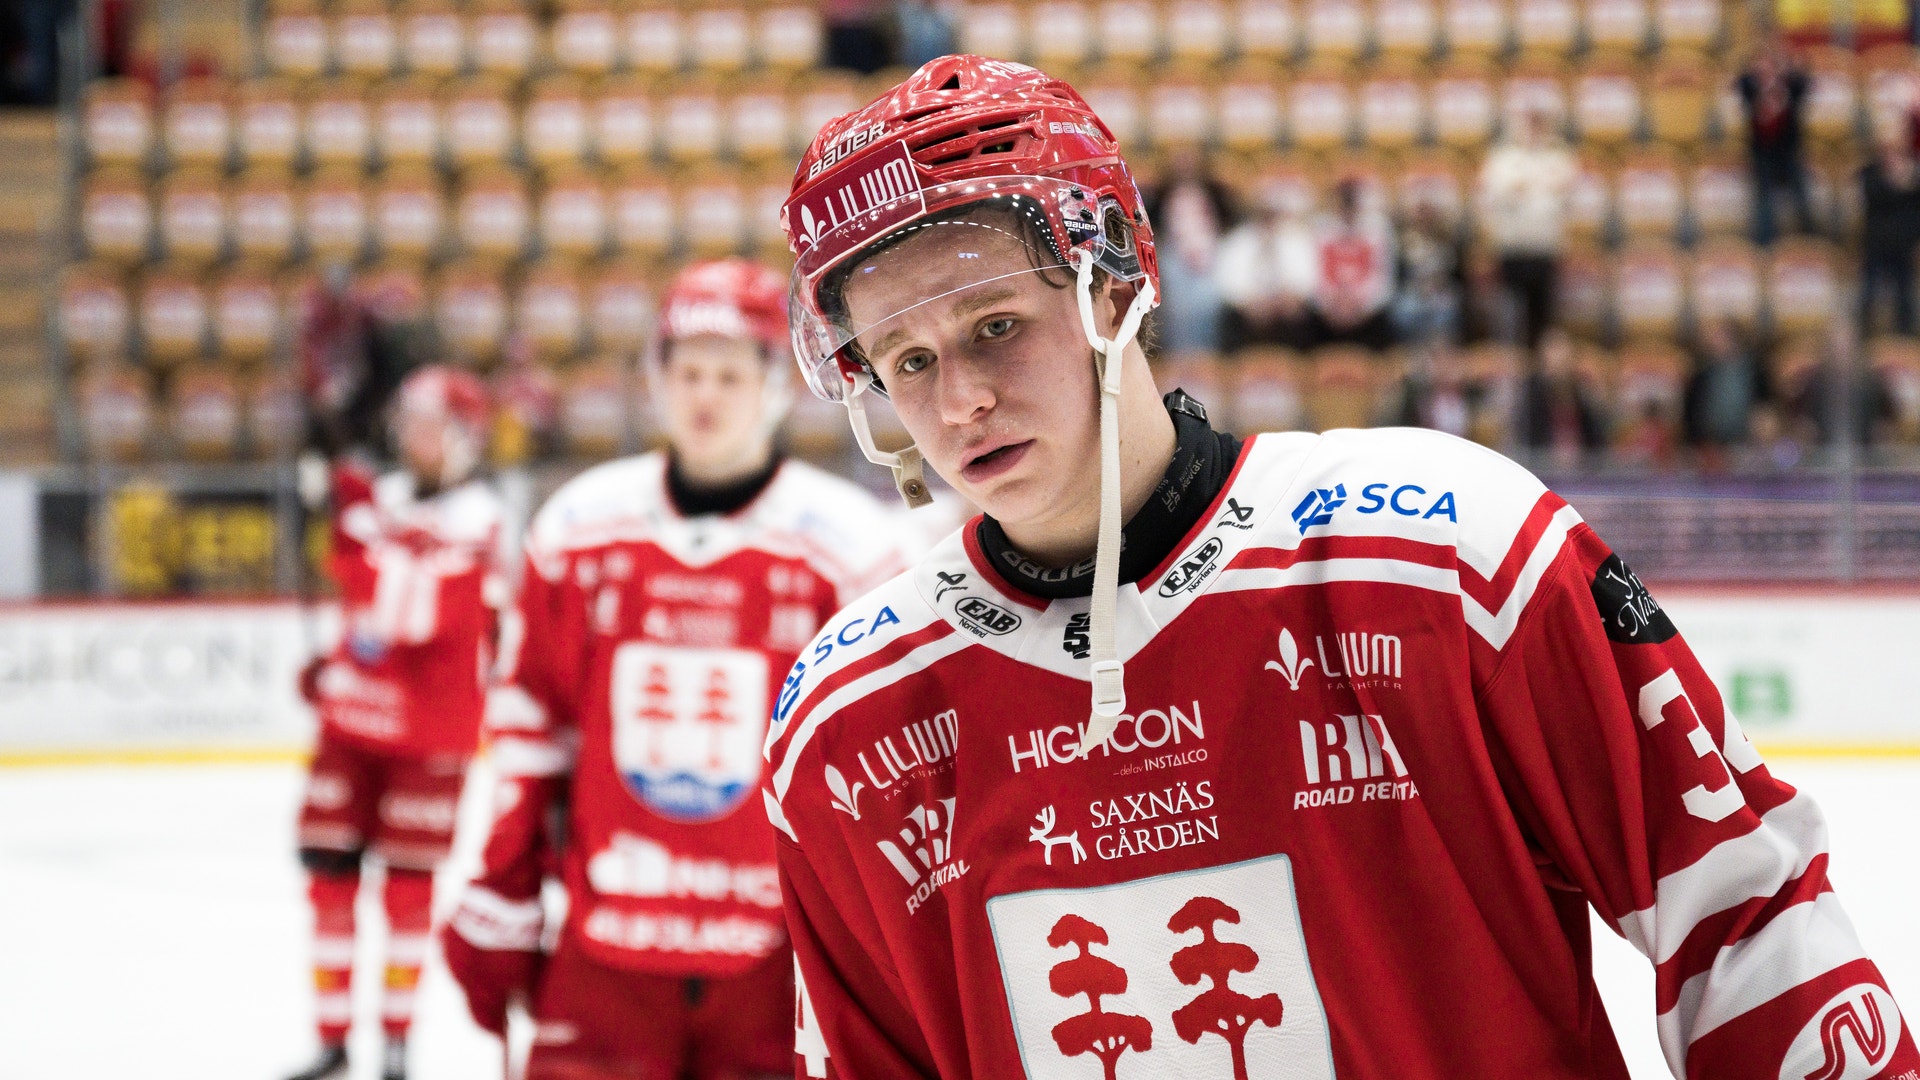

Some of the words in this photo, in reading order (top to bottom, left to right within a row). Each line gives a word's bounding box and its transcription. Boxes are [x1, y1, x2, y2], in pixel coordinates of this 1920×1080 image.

[808, 121, 886, 181] BAUER
[824, 158, 914, 228] LILIUM
[1064, 220, 1097, 232] BAUER
[1355, 483, 1458, 525] SCA
[1162, 542, 1219, 594] EAB
[1187, 562, 1218, 593] Norrland
[813, 605, 901, 667] SCA
[958, 599, 1017, 632] EAB
[958, 618, 988, 639] Norrland
[857, 708, 959, 790] LILIUM
[1144, 748, 1208, 772] INSTALCO
[1089, 780, 1215, 829] SAXNÄS
[1293, 786, 1355, 811] ROAD
[1362, 780, 1420, 802] RENTA
[1095, 815, 1220, 861] GÅRDEN
